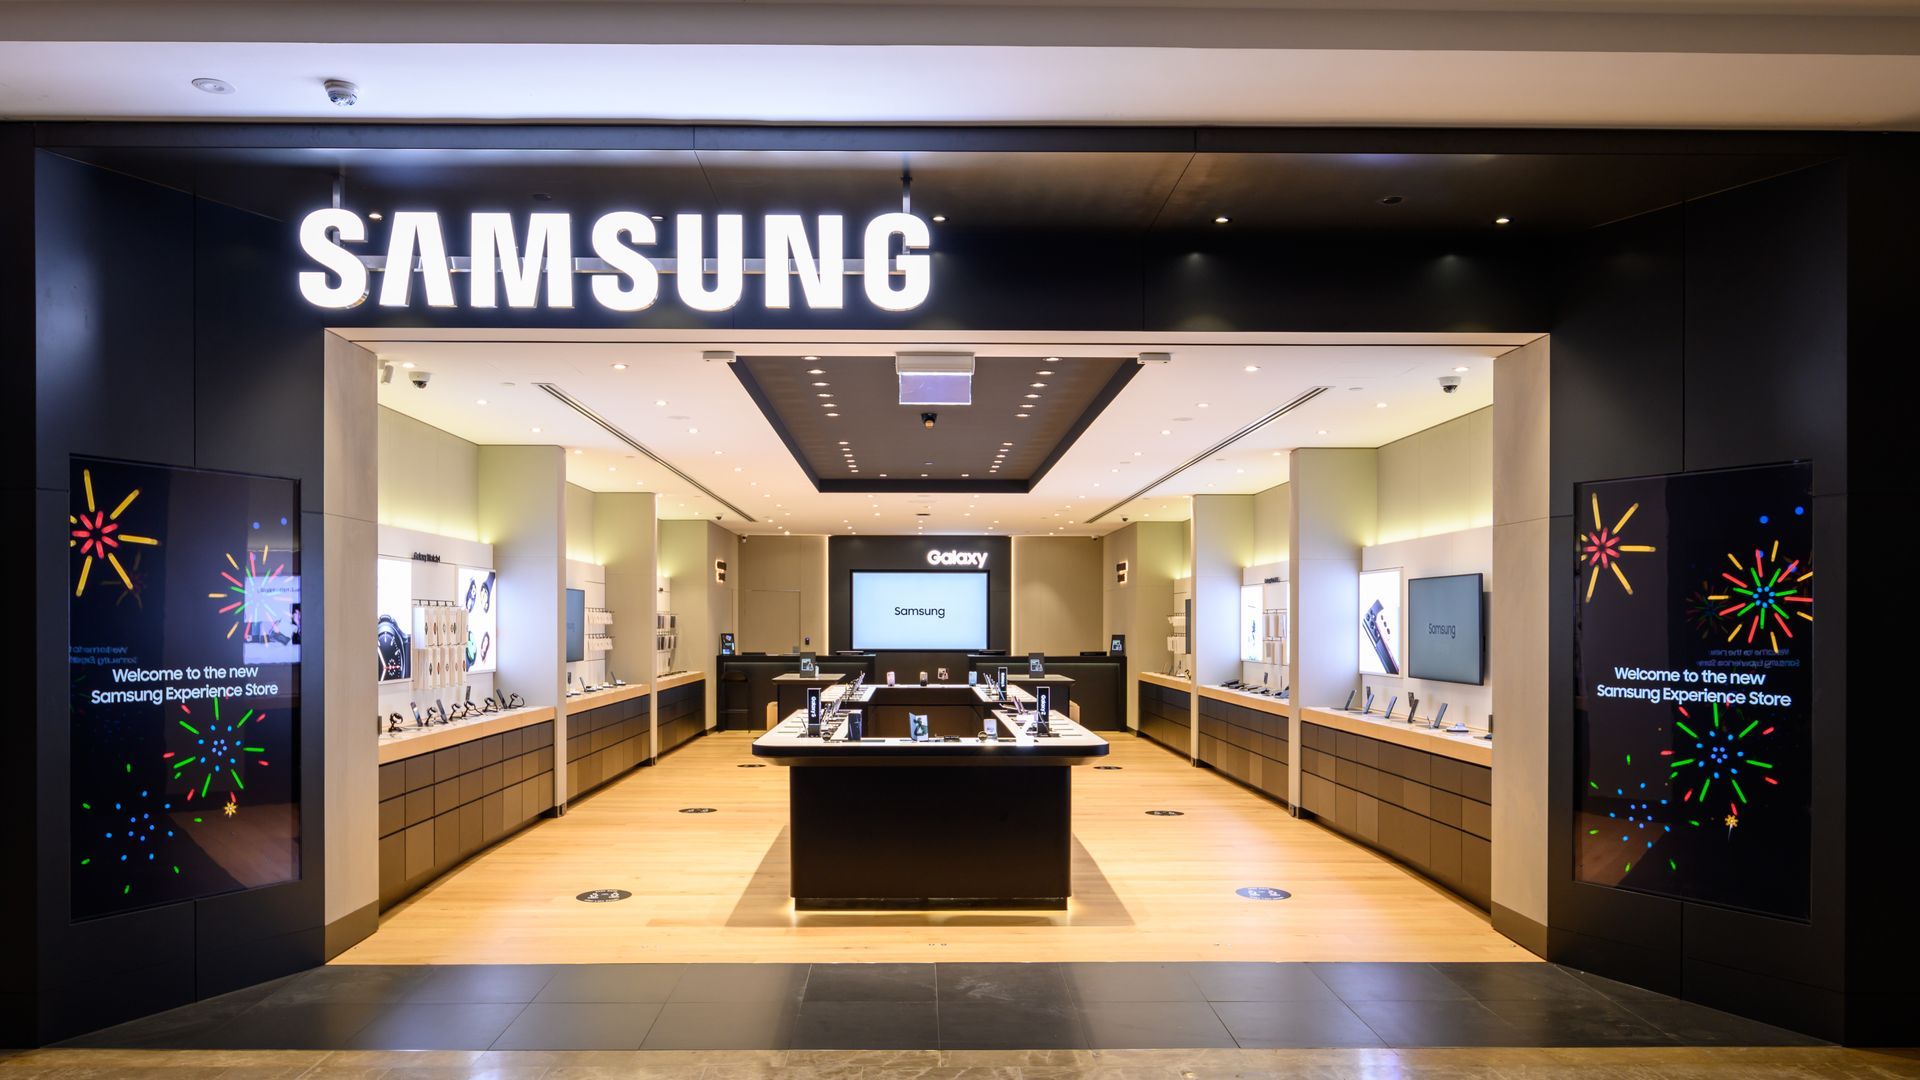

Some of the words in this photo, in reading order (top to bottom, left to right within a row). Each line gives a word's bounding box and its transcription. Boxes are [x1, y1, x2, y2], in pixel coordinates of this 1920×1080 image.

[298, 207, 932, 312] SAMSUNG
[926, 549, 989, 569] Galaxy
[894, 606, 946, 619] Samsung
[1428, 623, 1456, 639] Samsung
[112, 667, 183, 683] Welcome
[185, 666, 201, 680] to
[203, 666, 227, 679] the
[229, 666, 259, 678] new
[1614, 667, 1681, 682] Welcome
[1682, 668, 1699, 683] to
[1701, 669, 1727, 684] the
[1730, 671, 1766, 685] new
[91, 687, 163, 705] Samsung
[165, 684, 243, 703] Experience
[245, 682, 279, 696] Store
[1596, 684, 1661, 704] Samsung
[1663, 687, 1746, 705] Experience
[1749, 691, 1792, 707] Store
